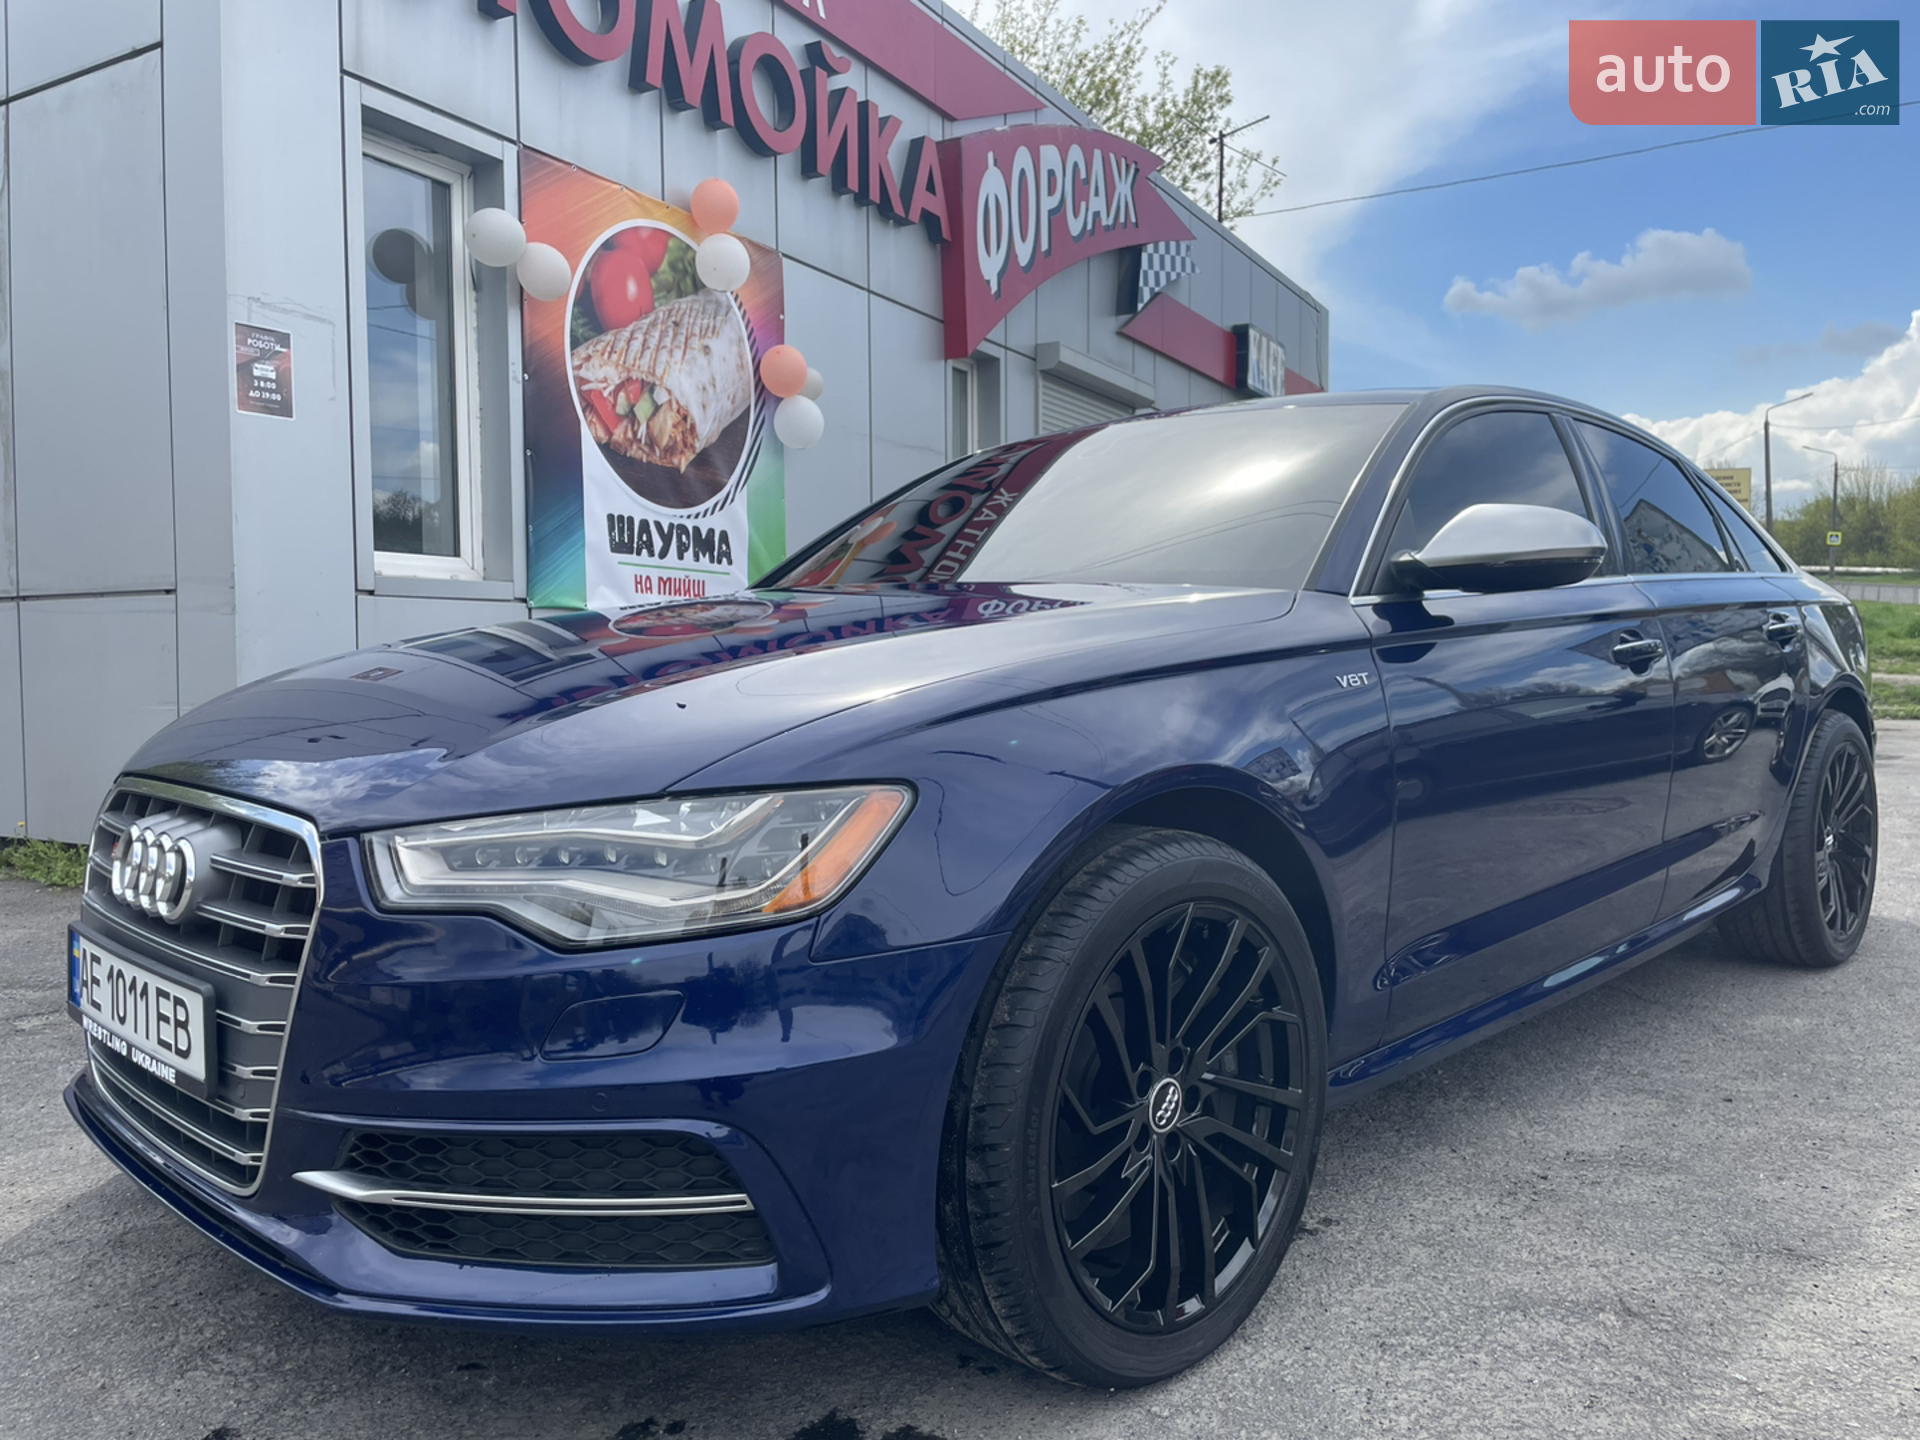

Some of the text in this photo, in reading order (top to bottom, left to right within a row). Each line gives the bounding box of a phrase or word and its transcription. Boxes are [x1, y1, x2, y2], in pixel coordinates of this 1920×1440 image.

[478, 0, 952, 243] МОЙКА
[976, 142, 1139, 297] ФОРСАЖ
[247, 338, 281, 350] РОБОТИ
[261, 391, 282, 401] 19:00
[606, 512, 733, 566] ШАУРМА
[634, 573, 653, 595] НА
[1335, 672, 1369, 688] V8T
[81, 947, 192, 1060] AE 1011 EB
[82, 1014, 177, 1084] WRESTLING UKRAINE
